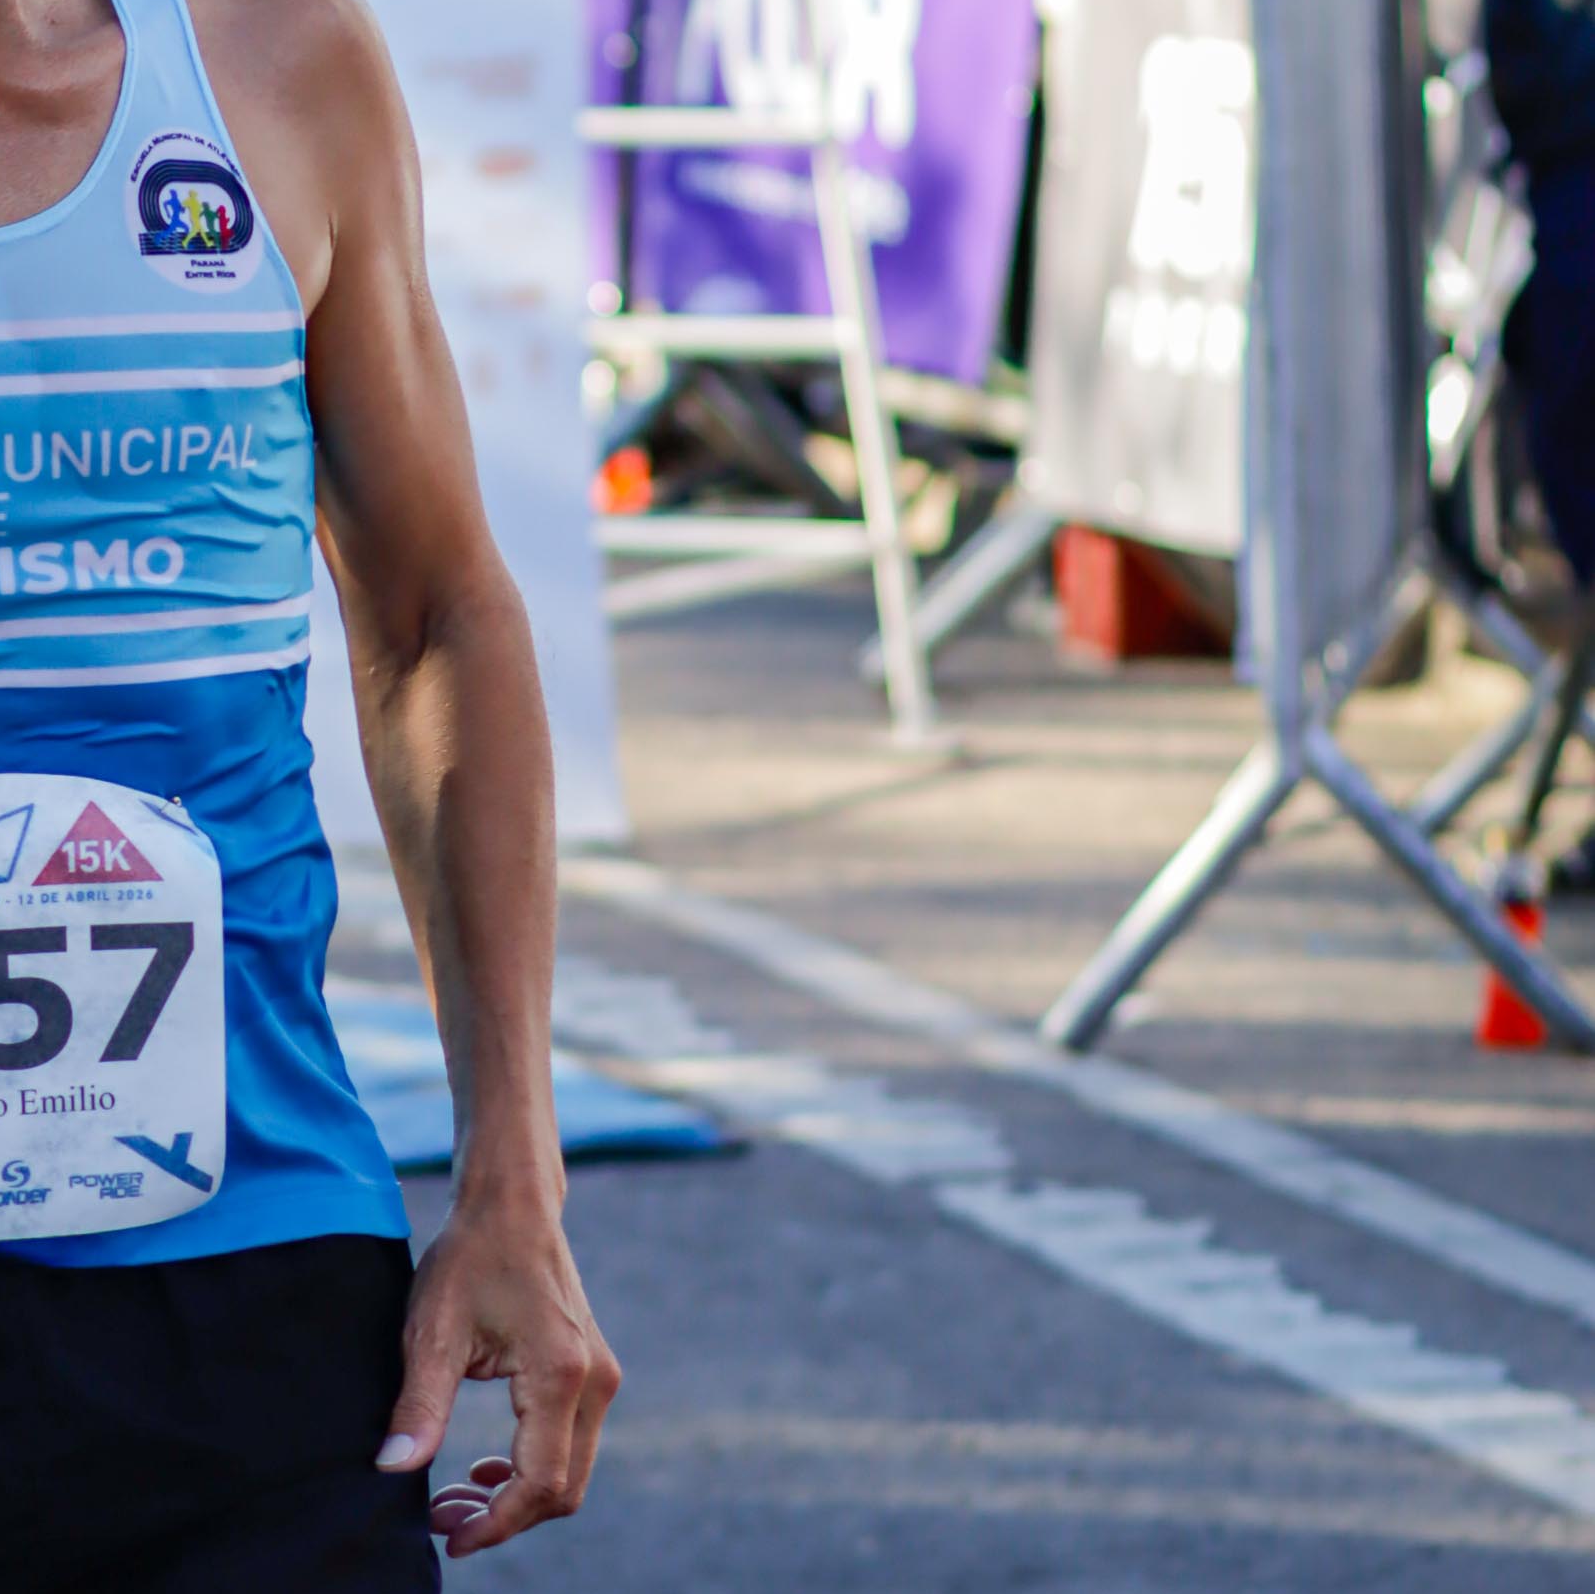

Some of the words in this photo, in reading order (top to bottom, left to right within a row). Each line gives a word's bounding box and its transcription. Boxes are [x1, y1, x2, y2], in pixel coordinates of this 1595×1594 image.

[62, 839, 131, 873] 15K
[18, 893, 34, 905] 12
[40, 892, 58, 904] DE
[66, 891, 110, 903] ABRIL
[117, 889, 154, 901] 2026
[19, 1085, 116, 1116] Emilio
[69, 1172, 144, 1188] POWER
